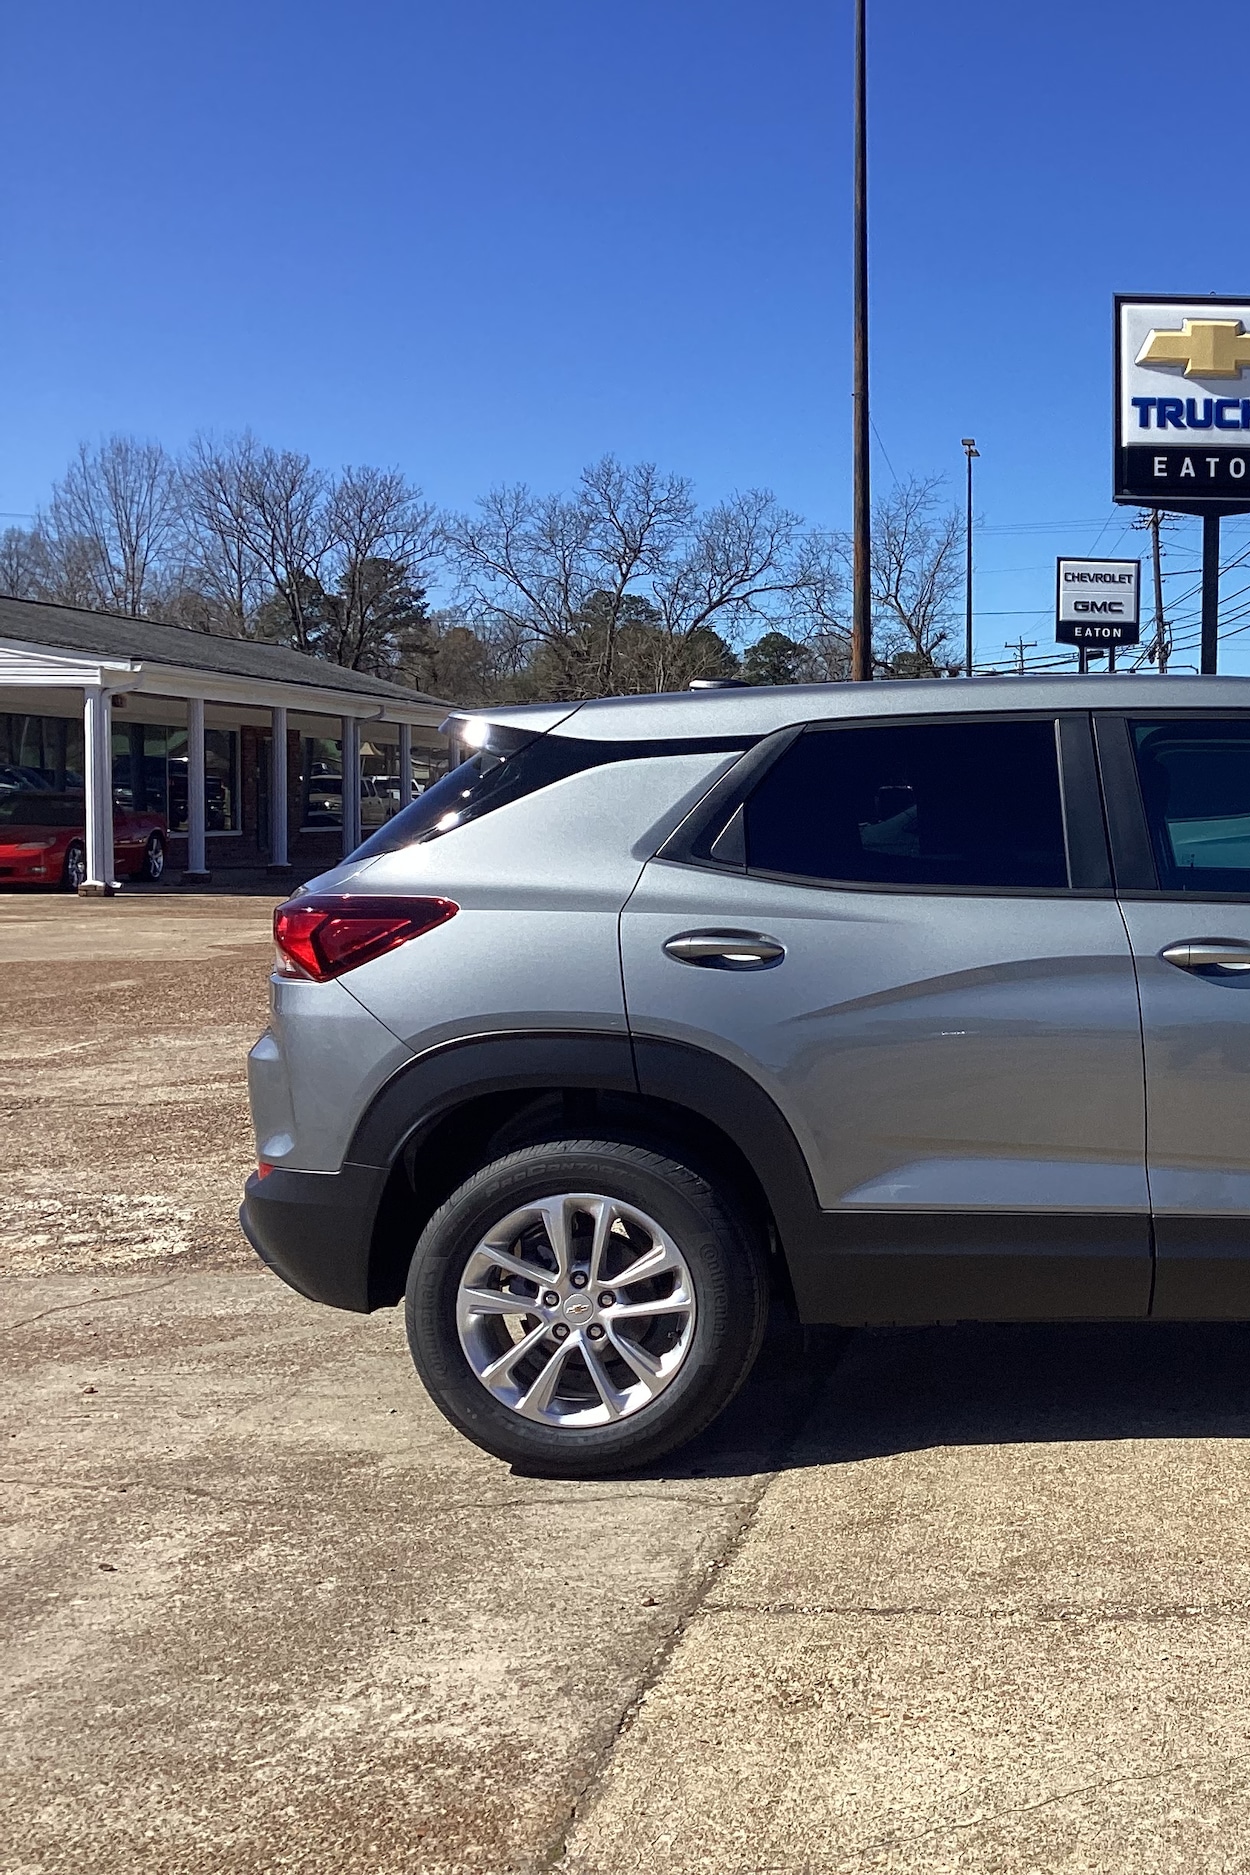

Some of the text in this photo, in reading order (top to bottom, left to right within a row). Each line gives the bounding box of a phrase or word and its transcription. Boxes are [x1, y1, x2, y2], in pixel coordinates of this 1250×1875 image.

[1064, 572, 1133, 584] CHEVROLET
[1073, 600, 1124, 614] GMC
[1074, 627, 1122, 638] EATON
